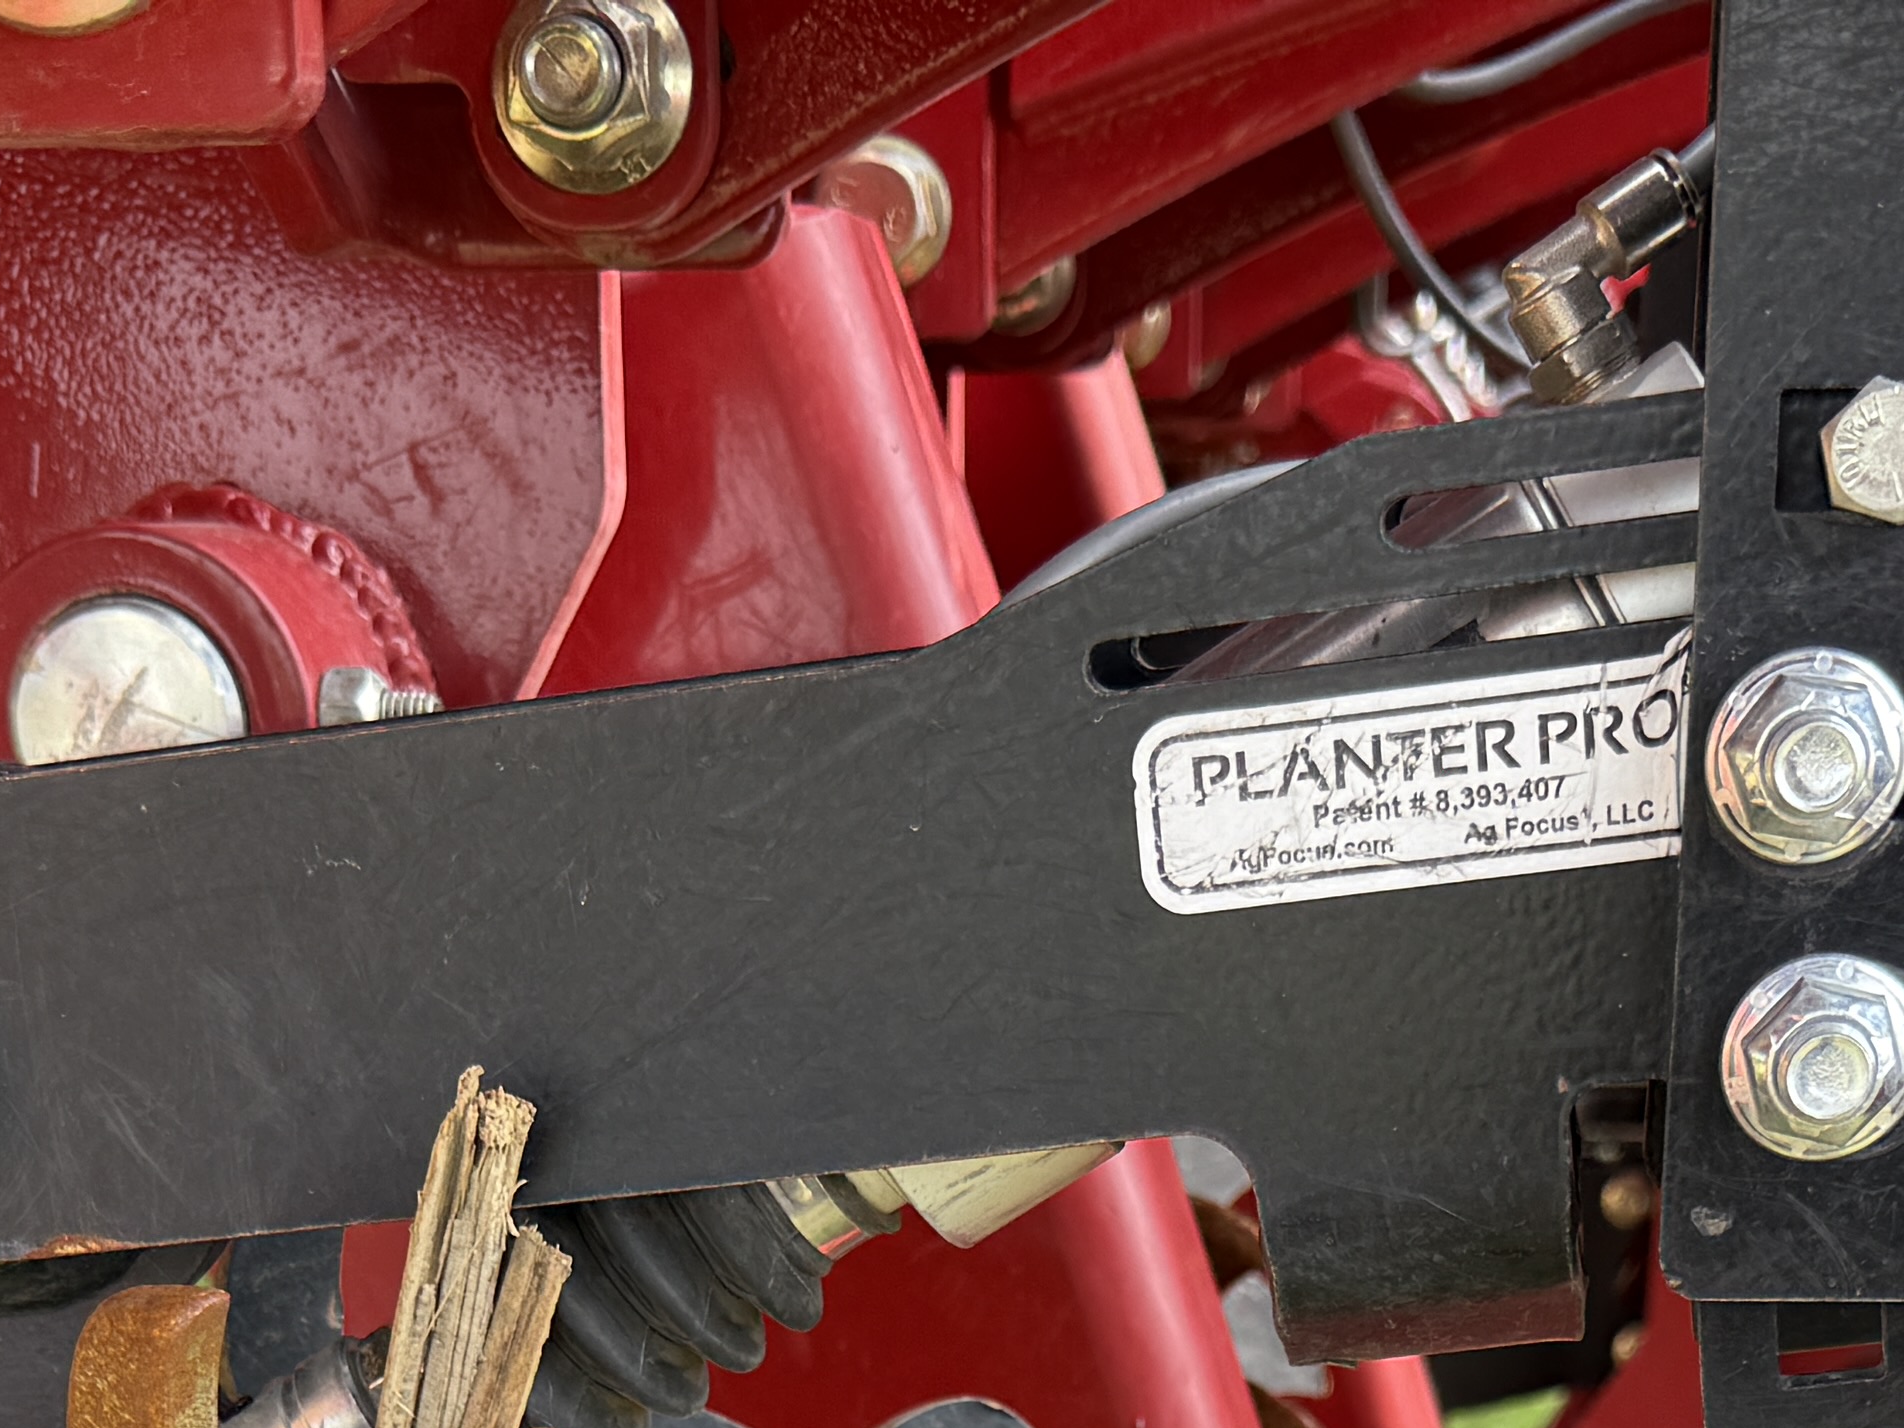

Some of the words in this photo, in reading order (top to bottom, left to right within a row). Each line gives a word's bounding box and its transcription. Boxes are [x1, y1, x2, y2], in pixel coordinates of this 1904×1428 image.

[1192, 718, 1522, 807] PLANTER
[1537, 688, 1679, 765] PRO
[1313, 797, 1402, 828] Patent
[1435, 775, 1566, 816] 8,393,407
[1464, 821, 1497, 846] Ag
[1606, 799, 1654, 826] LLC
